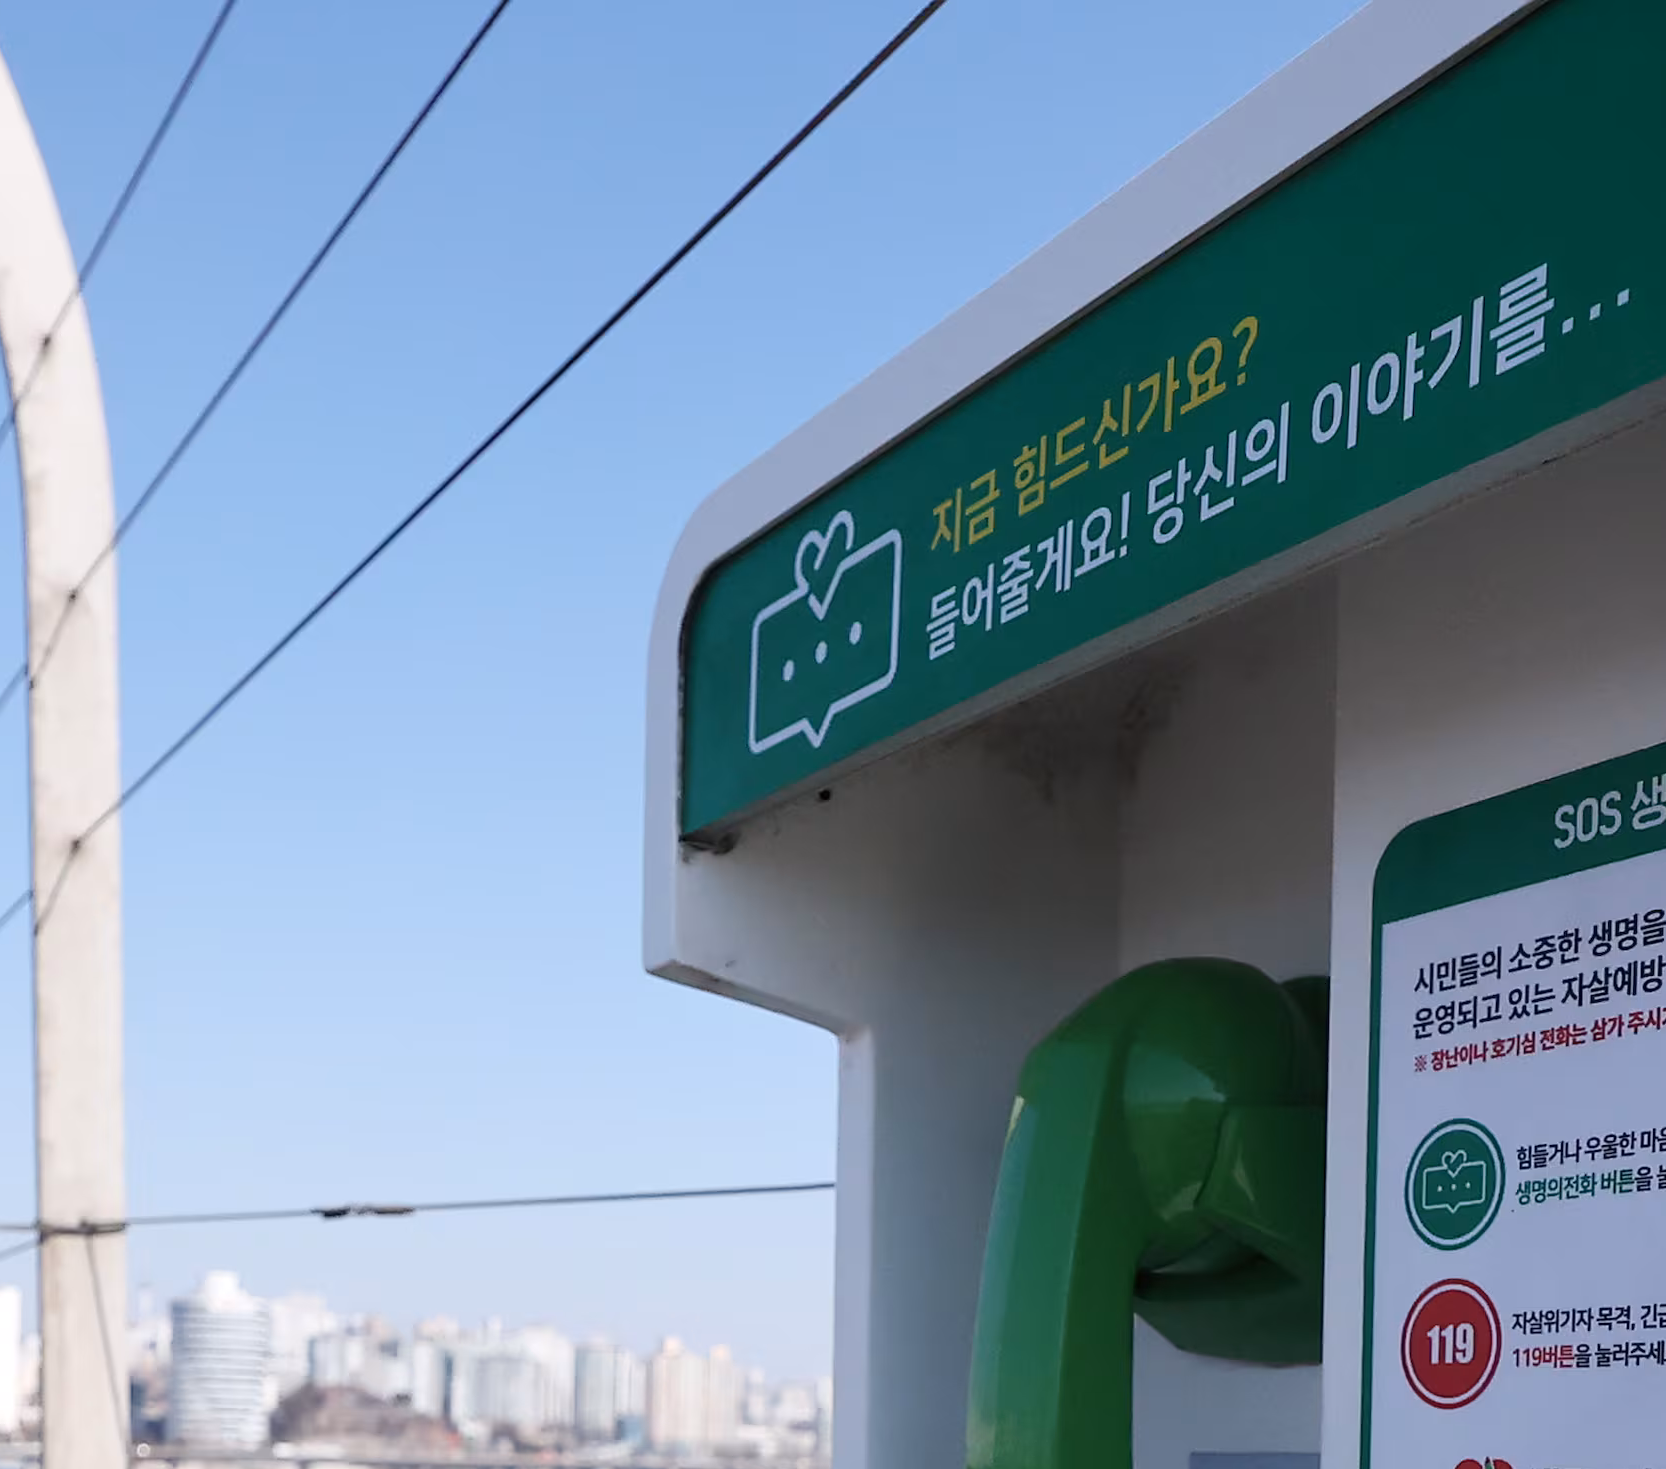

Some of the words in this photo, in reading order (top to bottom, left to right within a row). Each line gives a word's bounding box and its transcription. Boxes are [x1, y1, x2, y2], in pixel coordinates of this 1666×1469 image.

[932, 469, 1001, 552] 지금
[1013, 316, 1258, 517] 힘드신가요?
[926, 492, 1130, 660] 들어줄게요!
[1147, 401, 1290, 544] 당신의
[1554, 791, 1622, 849] SOS
[1414, 946, 1503, 995] 시민들의
[1508, 928, 1583, 975] 소중한
[1588, 909, 1666, 957] 생명을
[1413, 994, 1503, 1041] 운영되고
[1508, 982, 1556, 1020] 있는
[1561, 955, 1666, 1008] 자살예방
[1431, 1043, 1489, 1072] 장난이나
[1490, 1032, 1537, 1059] 호기심
[1539, 1022, 1588, 1051] 전화는
[1590, 1013, 1625, 1043] 삼가
[1517, 1138, 1582, 1170] 힘들거나
[1584, 1131, 1637, 1161] 우울한
[1515, 1172, 1598, 1205] 생명의전화
[1600, 1165, 1653, 1194] 버튼을
[1426, 1322, 1476, 1365] 119
[1511, 1307, 1594, 1335] 자살위기자
[1596, 1304, 1636, 1332] 목격,
[1512, 1343, 1592, 1369] 119버튼을
